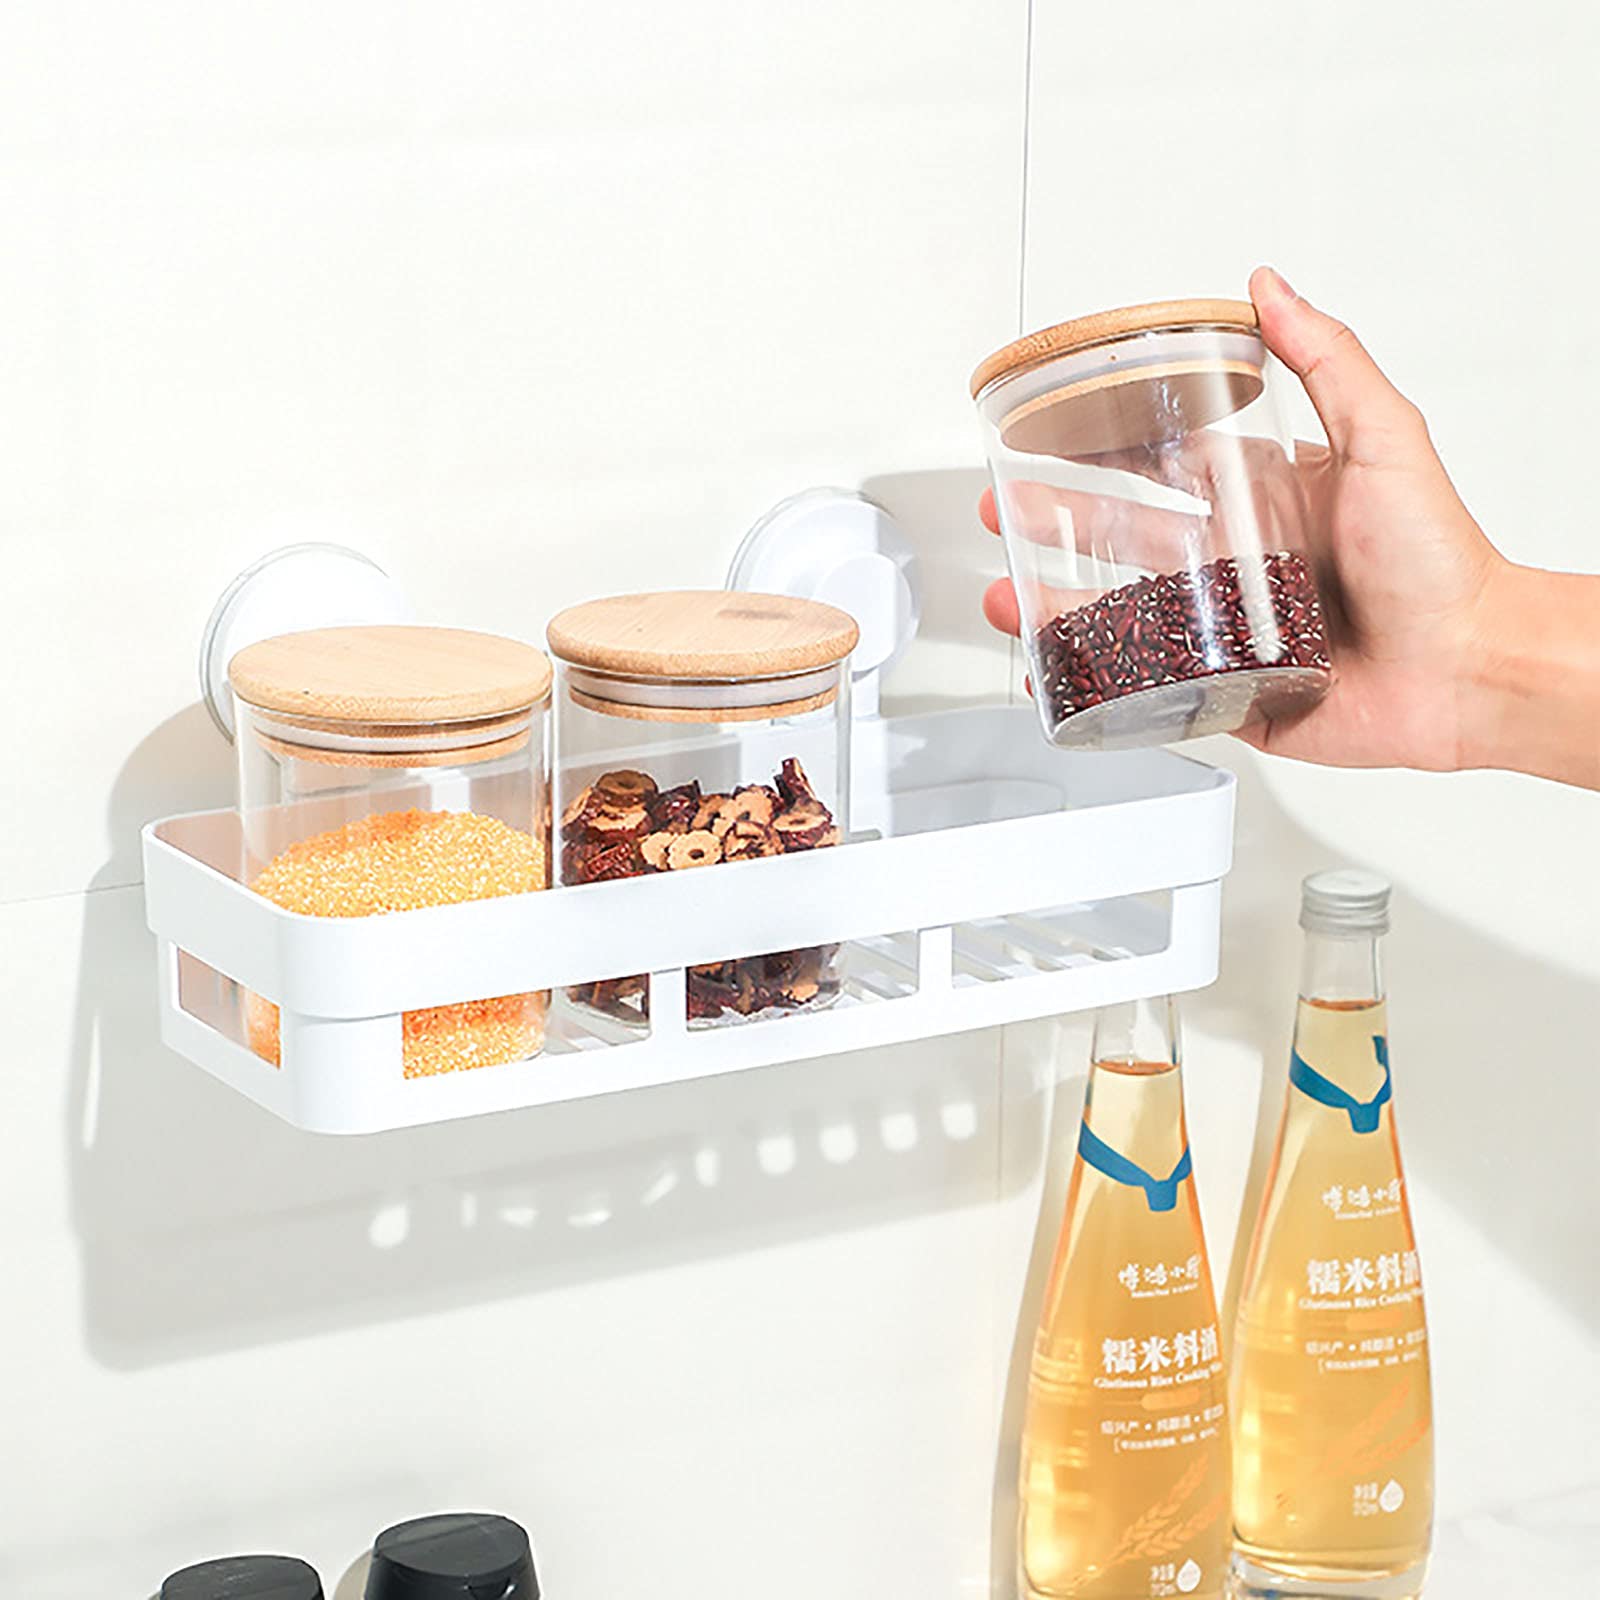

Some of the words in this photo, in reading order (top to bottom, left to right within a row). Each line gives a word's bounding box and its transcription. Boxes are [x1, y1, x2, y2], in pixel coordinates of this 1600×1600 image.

[1101, 1323, 1218, 1373] 糯米料酒
[1150, 1375, 1173, 1386] Rice
